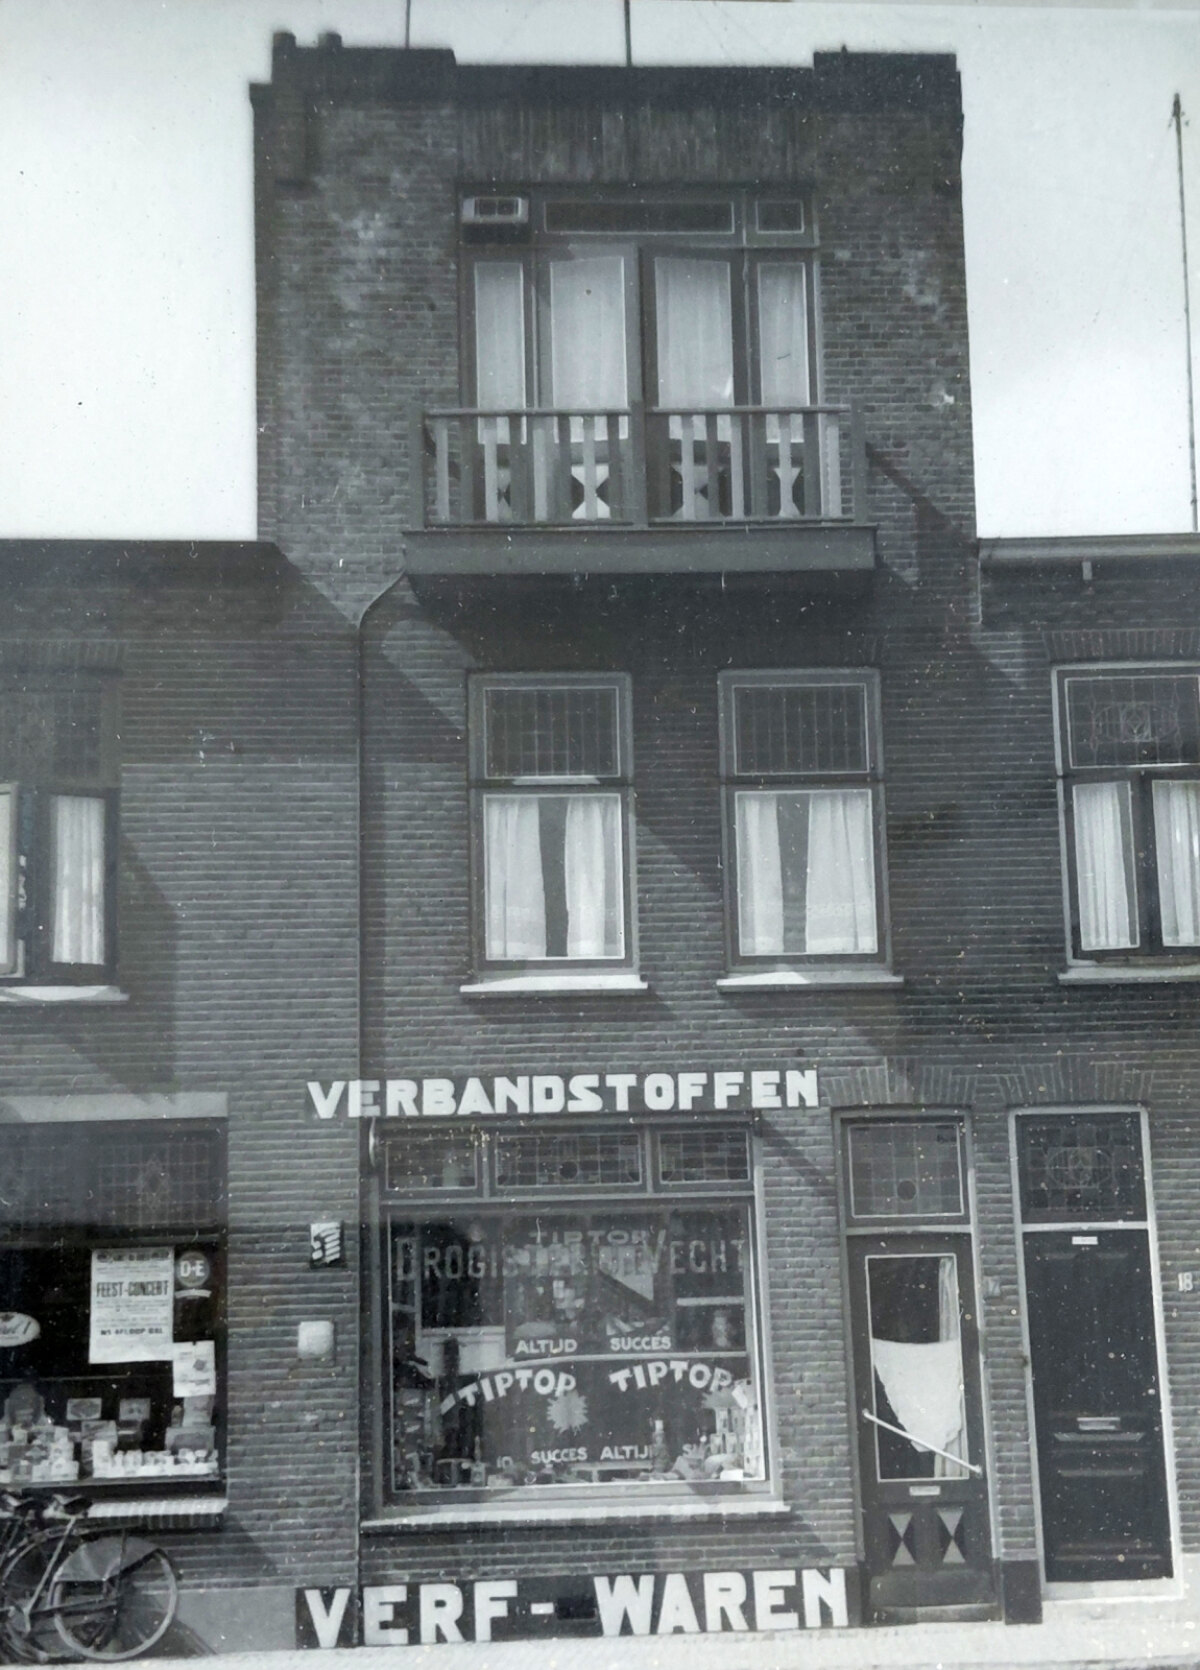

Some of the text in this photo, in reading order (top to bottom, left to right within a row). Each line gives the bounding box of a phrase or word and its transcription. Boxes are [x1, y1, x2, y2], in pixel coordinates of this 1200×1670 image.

[307, 1070, 819, 1119] VERBANDSTOFFEN
[1178, 1272, 1193, 1291] 18
[515, 1336, 672, 1354] ALTIJD SUCCES
[458, 1360, 733, 1407] TIPTOP TIPTOP
[531, 1446, 588, 1465] SUCCES
[600, 1445, 655, 1460] ALTIJ
[594, 1568, 849, 1637] WAREN
